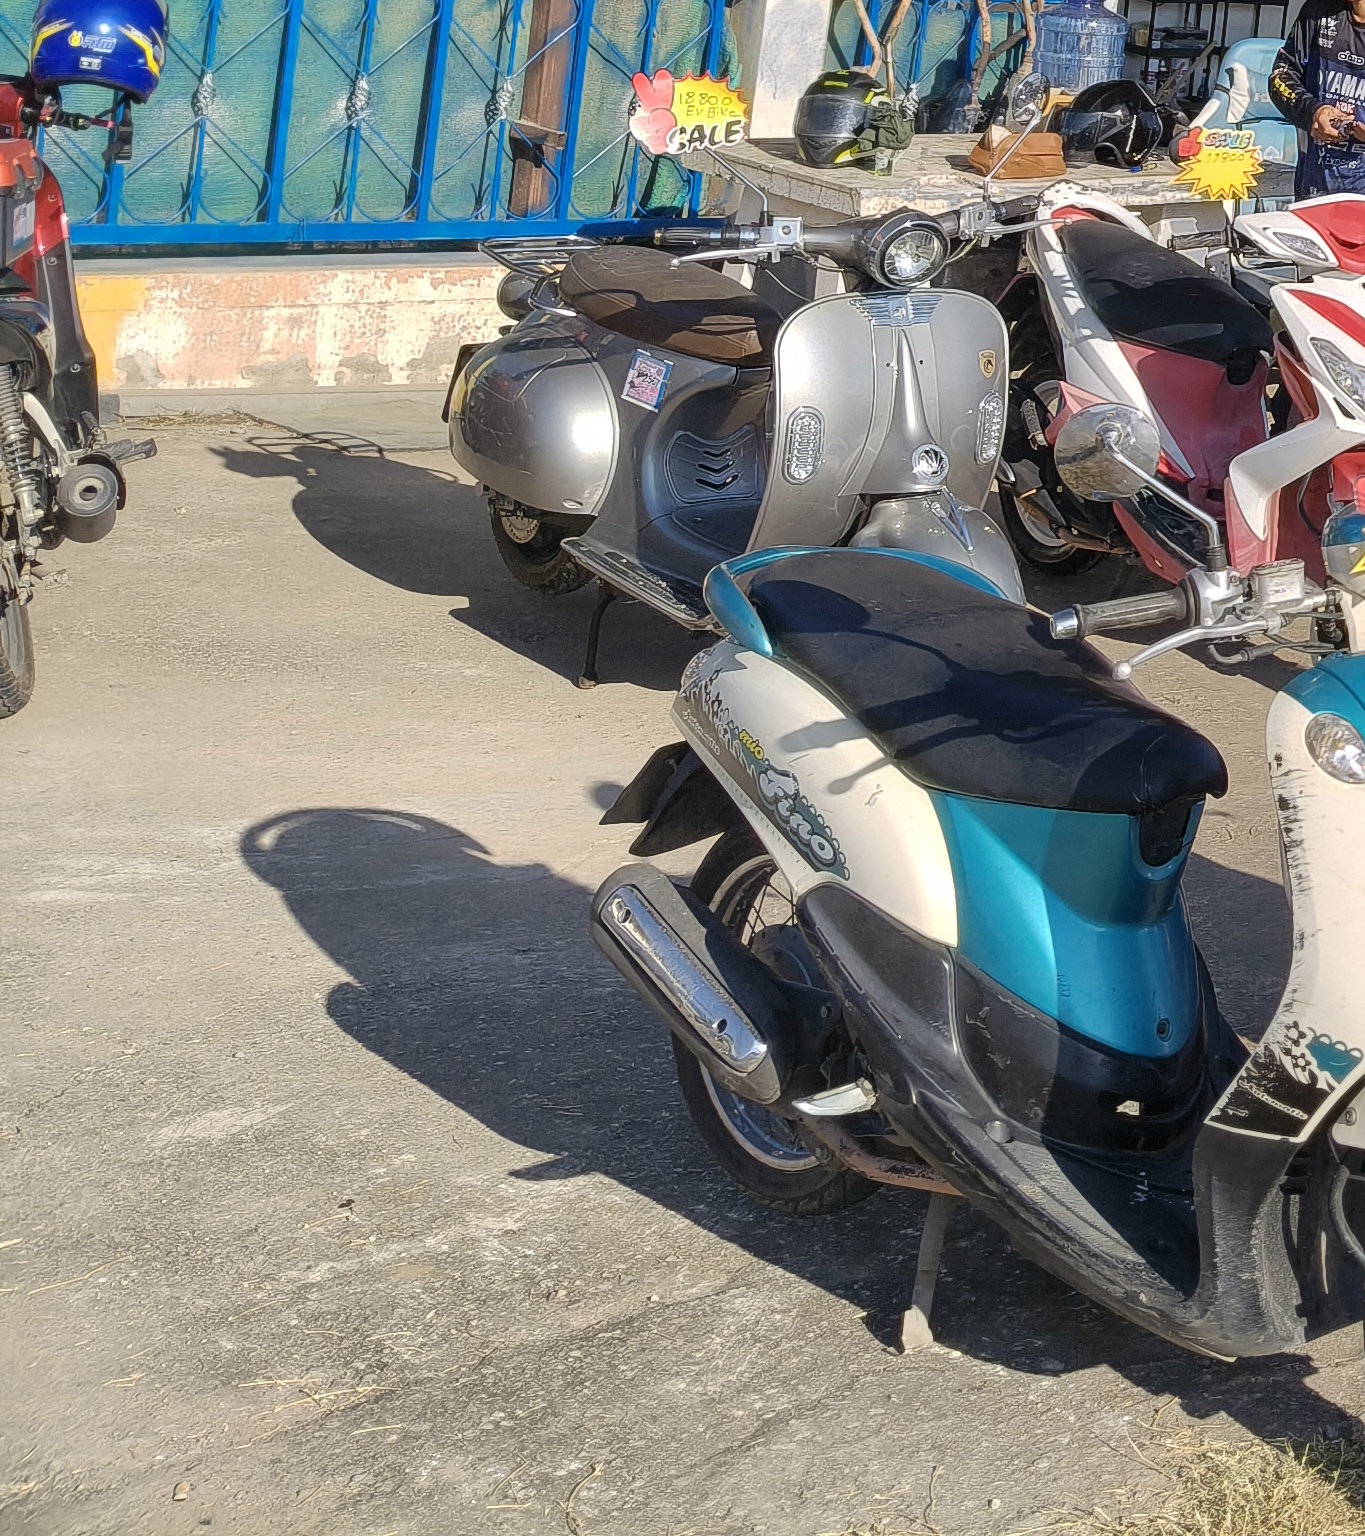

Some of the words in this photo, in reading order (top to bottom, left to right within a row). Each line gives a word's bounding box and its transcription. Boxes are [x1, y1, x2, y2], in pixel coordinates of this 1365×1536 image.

[668, 119, 742, 152] SALE
[1204, 132, 1252, 149] SALE
[738, 729, 764, 761] mio
